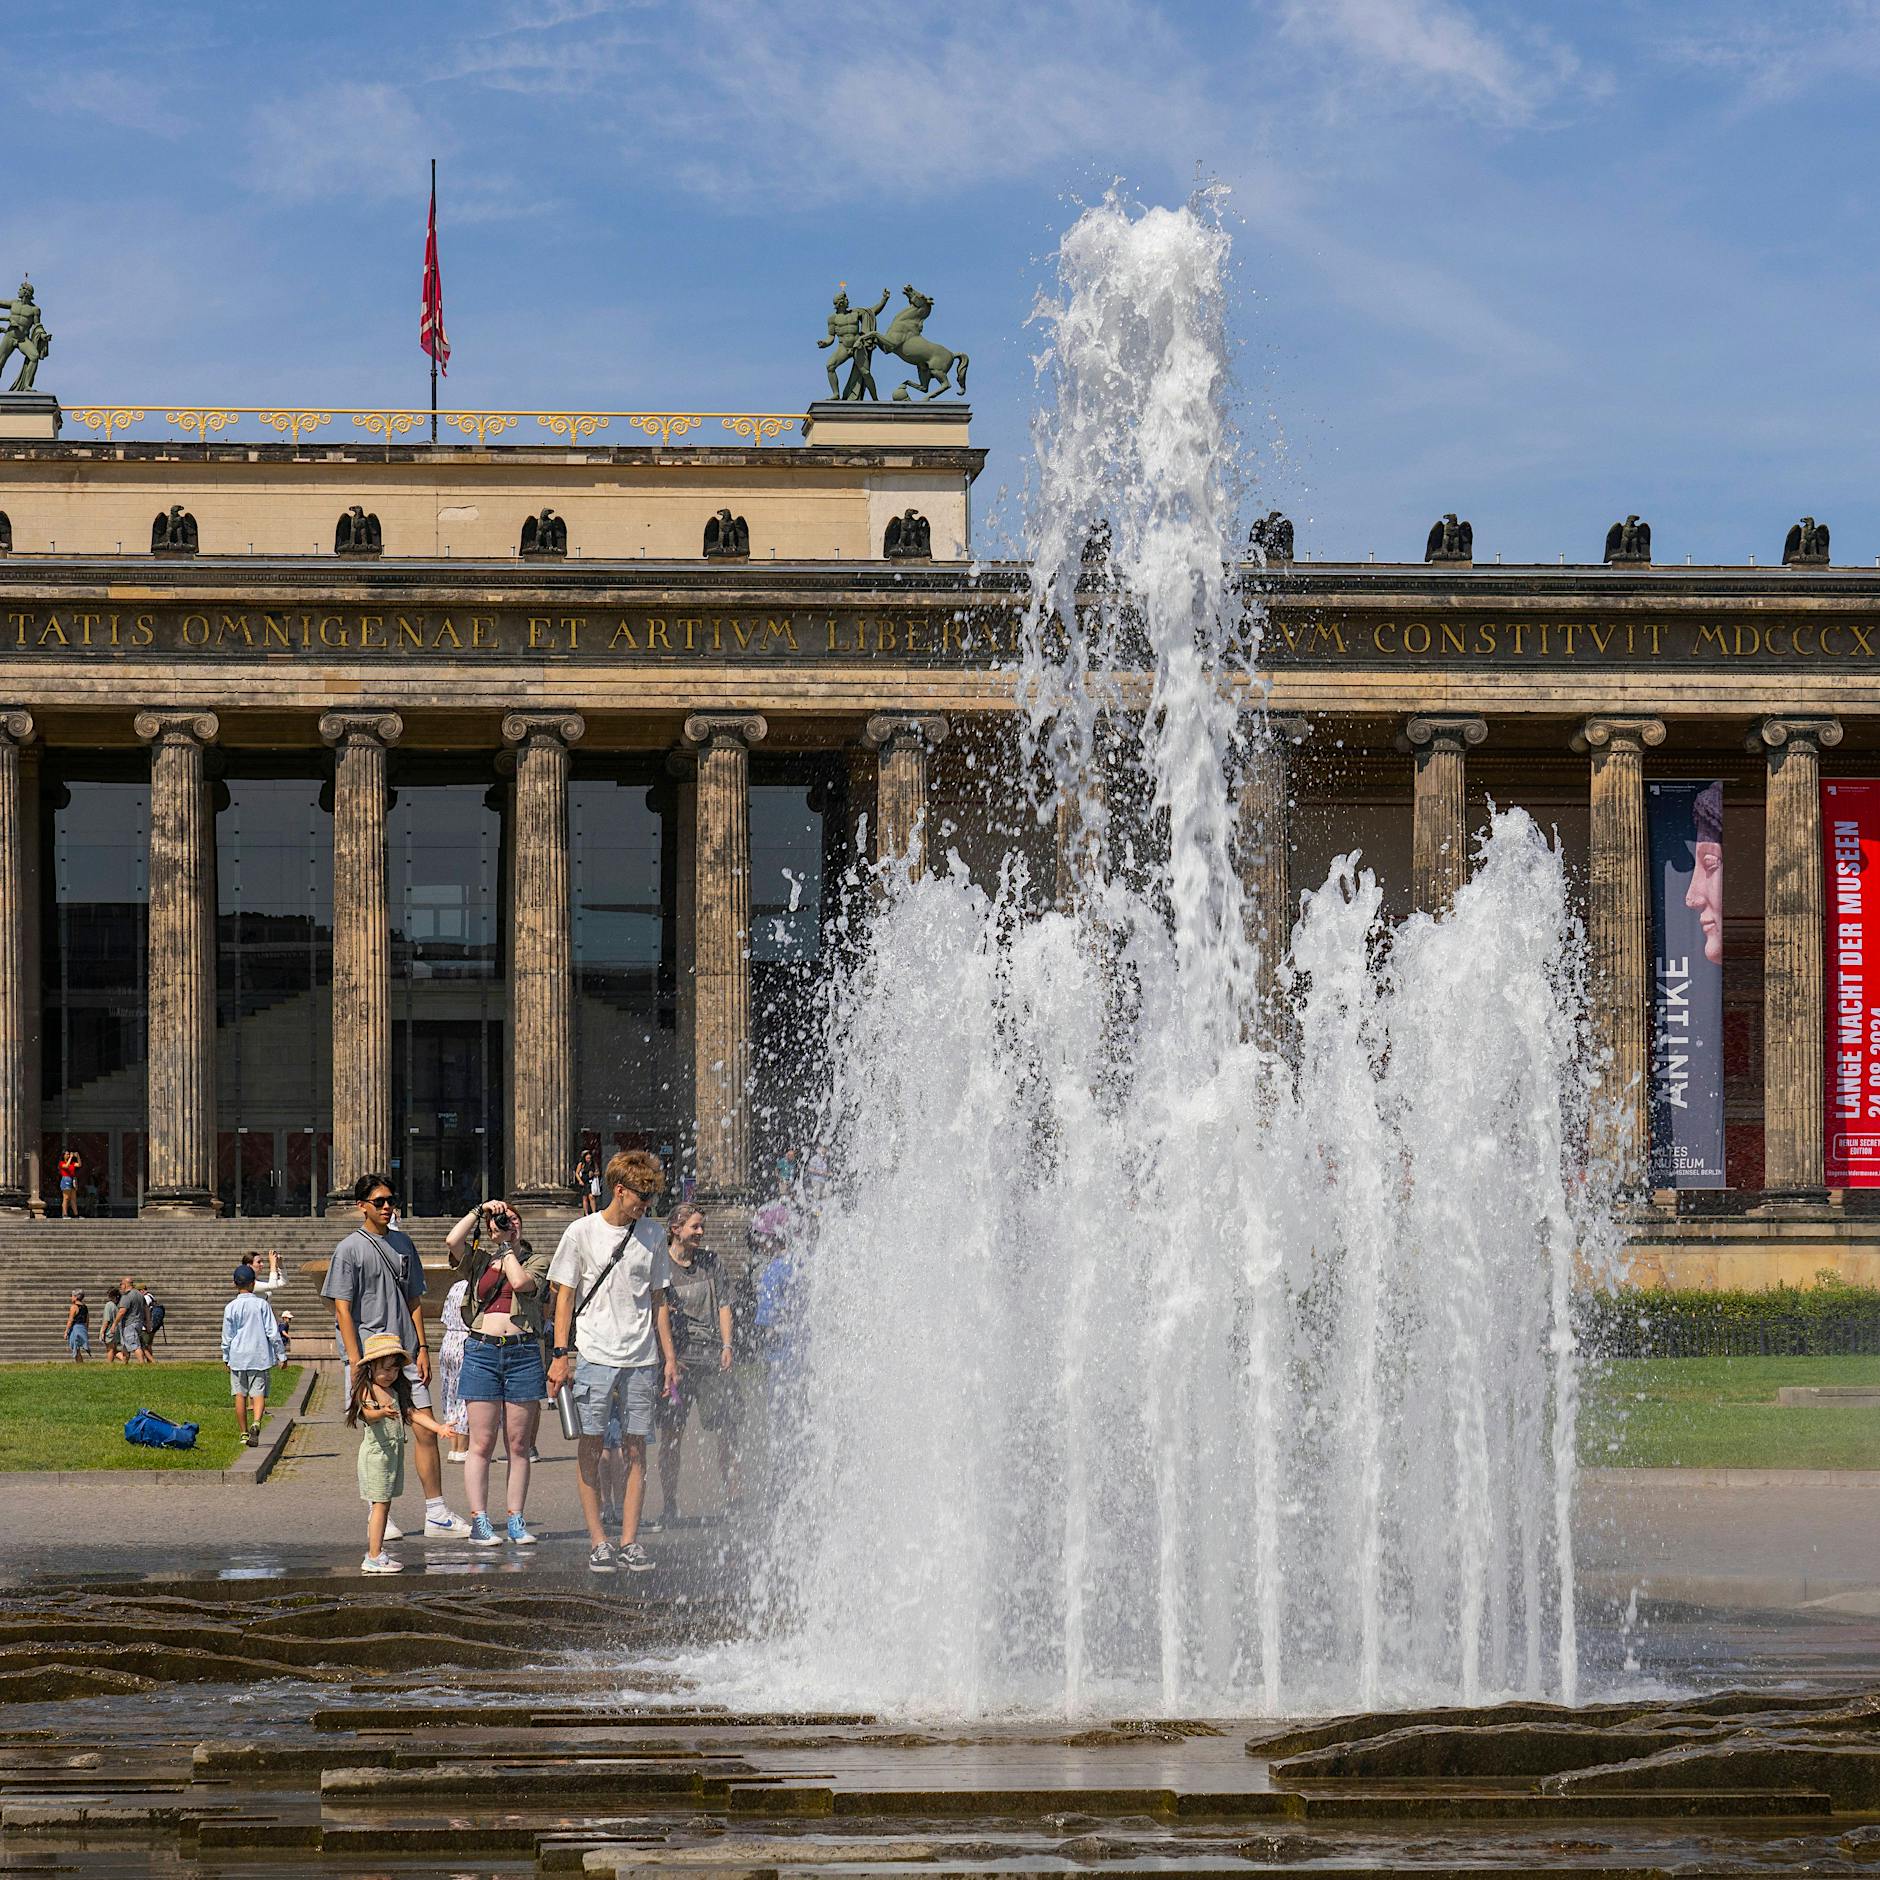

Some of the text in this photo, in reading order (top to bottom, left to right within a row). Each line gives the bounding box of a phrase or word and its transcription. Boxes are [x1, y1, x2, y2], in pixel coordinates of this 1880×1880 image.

[8, 613, 155, 646] TATIS
[182, 614, 499, 649] OMNIGENAE
[527, 617, 587, 649] ET
[608, 617, 799, 651] ARTIVM
[1373, 622, 1669, 655] CONSTITVIT
[1691, 624, 1876, 656] MDCCCX
[1834, 821, 1862, 914] MUSEEN
[1838, 923, 1863, 966] DER
[1838, 971, 1863, 1044] NACHT
[1655, 956, 1689, 1109] ANTIKE
[1836, 1050, 1862, 1118] LANGE
[1654, 1147, 1688, 1157] ALTES
[1654, 1158, 1704, 1169] MUSEUM
[1838, 1138, 1880, 1147] BERLIN SECRET
[1850, 1147, 1873, 1155] EDITION
